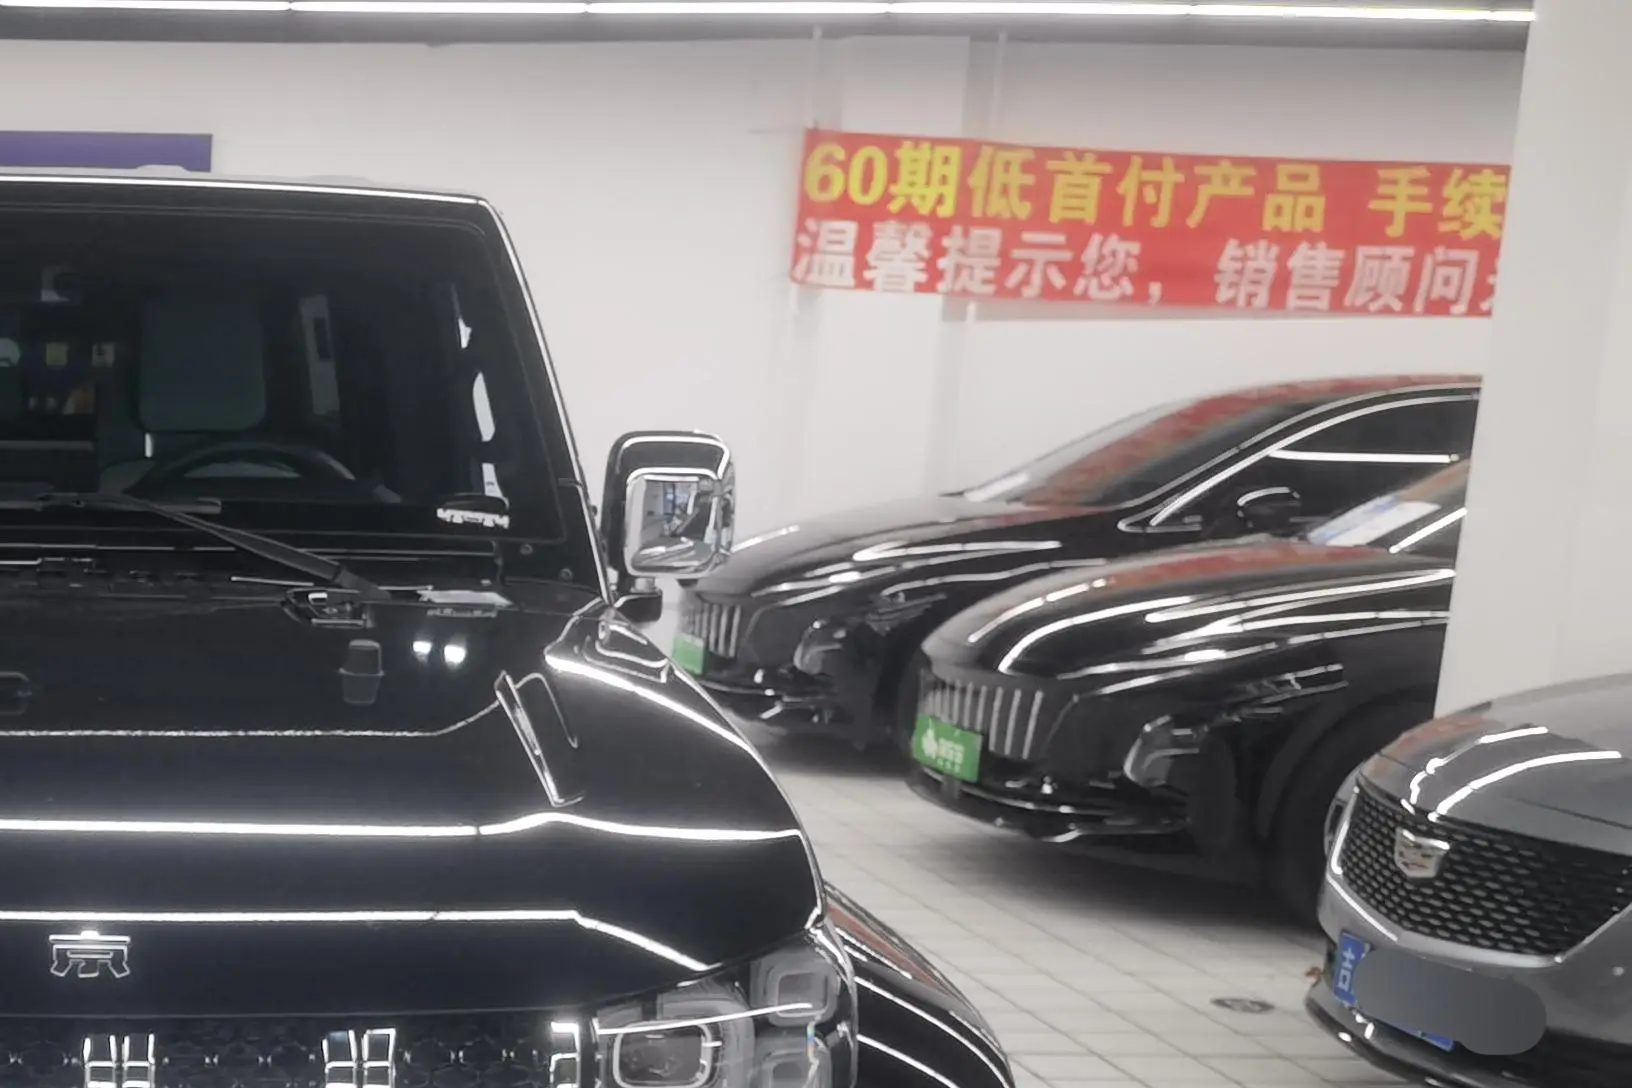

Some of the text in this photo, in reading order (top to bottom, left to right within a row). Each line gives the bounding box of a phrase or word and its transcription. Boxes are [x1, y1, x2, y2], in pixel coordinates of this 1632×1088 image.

[804, 140, 1327, 233] 60期低首付产品
